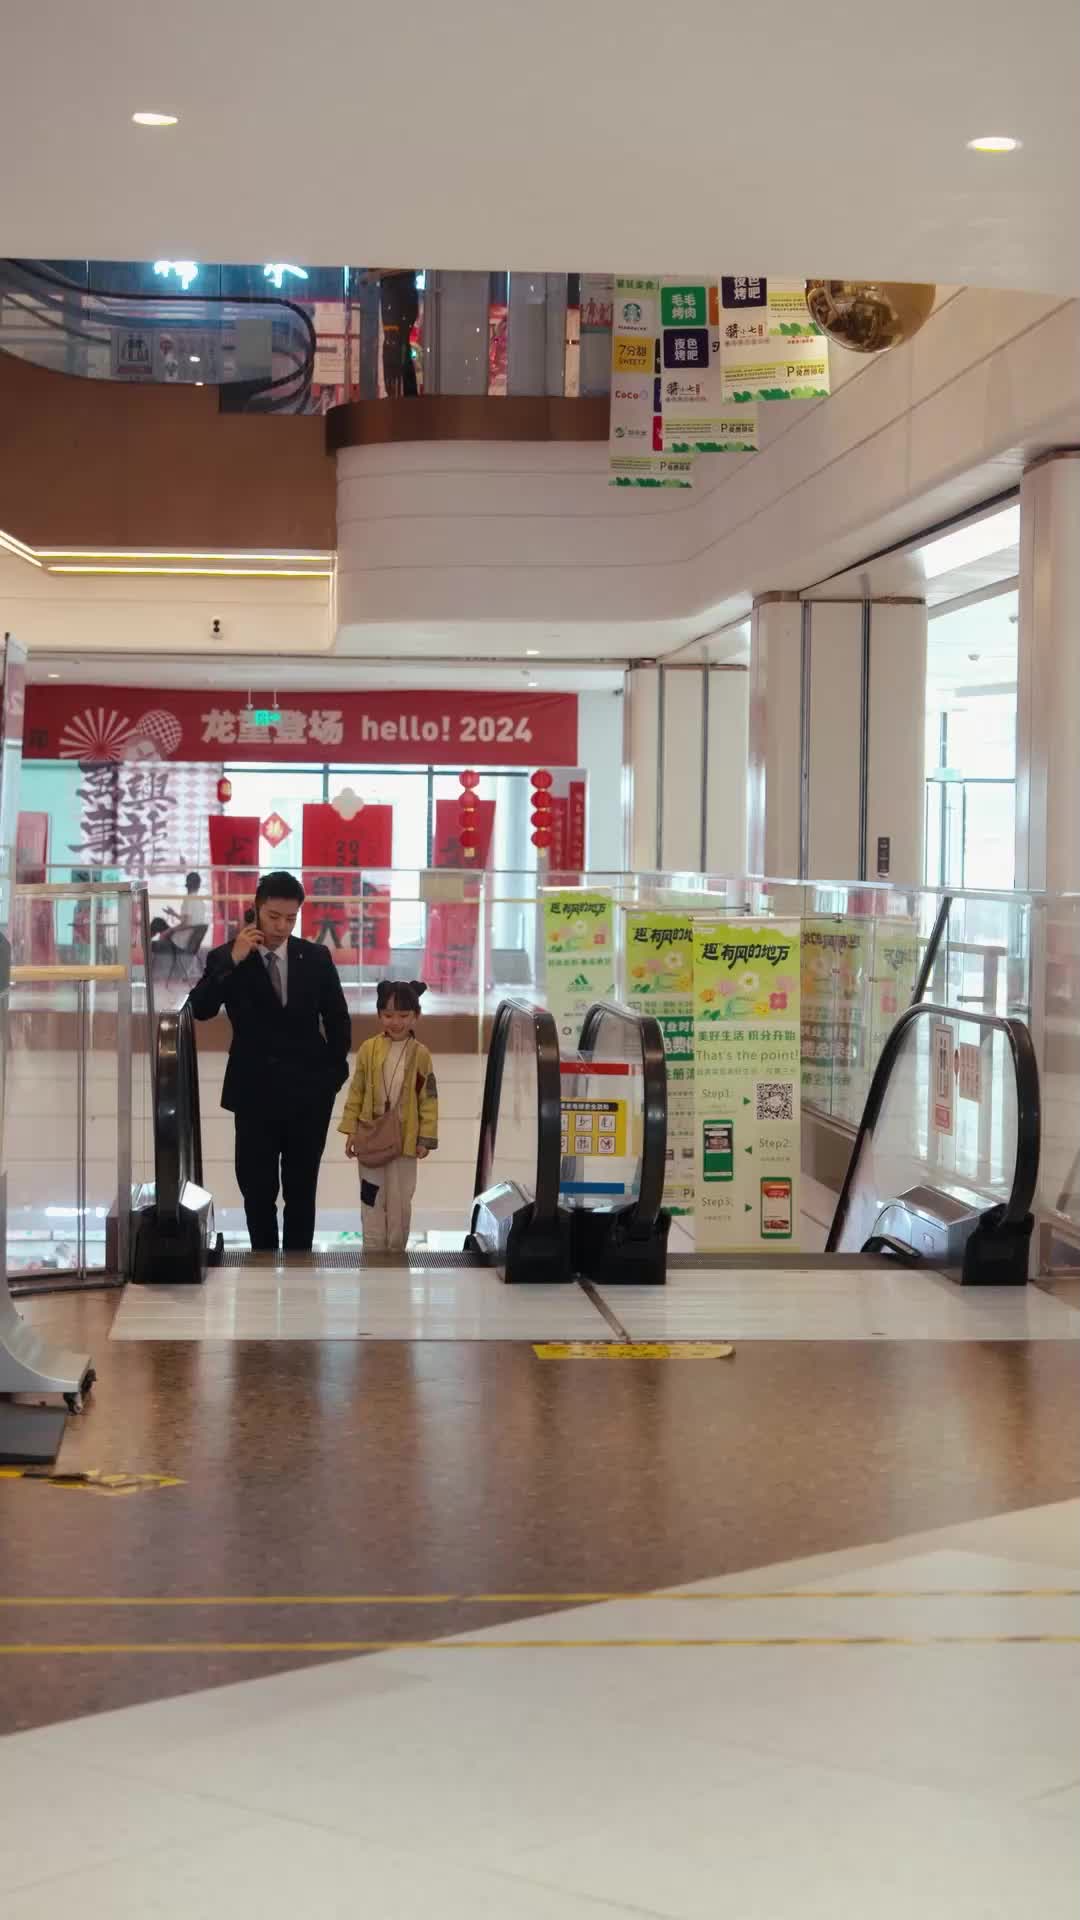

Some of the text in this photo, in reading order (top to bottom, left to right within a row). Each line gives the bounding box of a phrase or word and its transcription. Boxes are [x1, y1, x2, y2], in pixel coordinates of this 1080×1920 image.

[672, 294, 696, 306] 毛毛
[361, 715, 533, 743] hello! 2024
[696, 1049, 799, 1064] That's the point!
